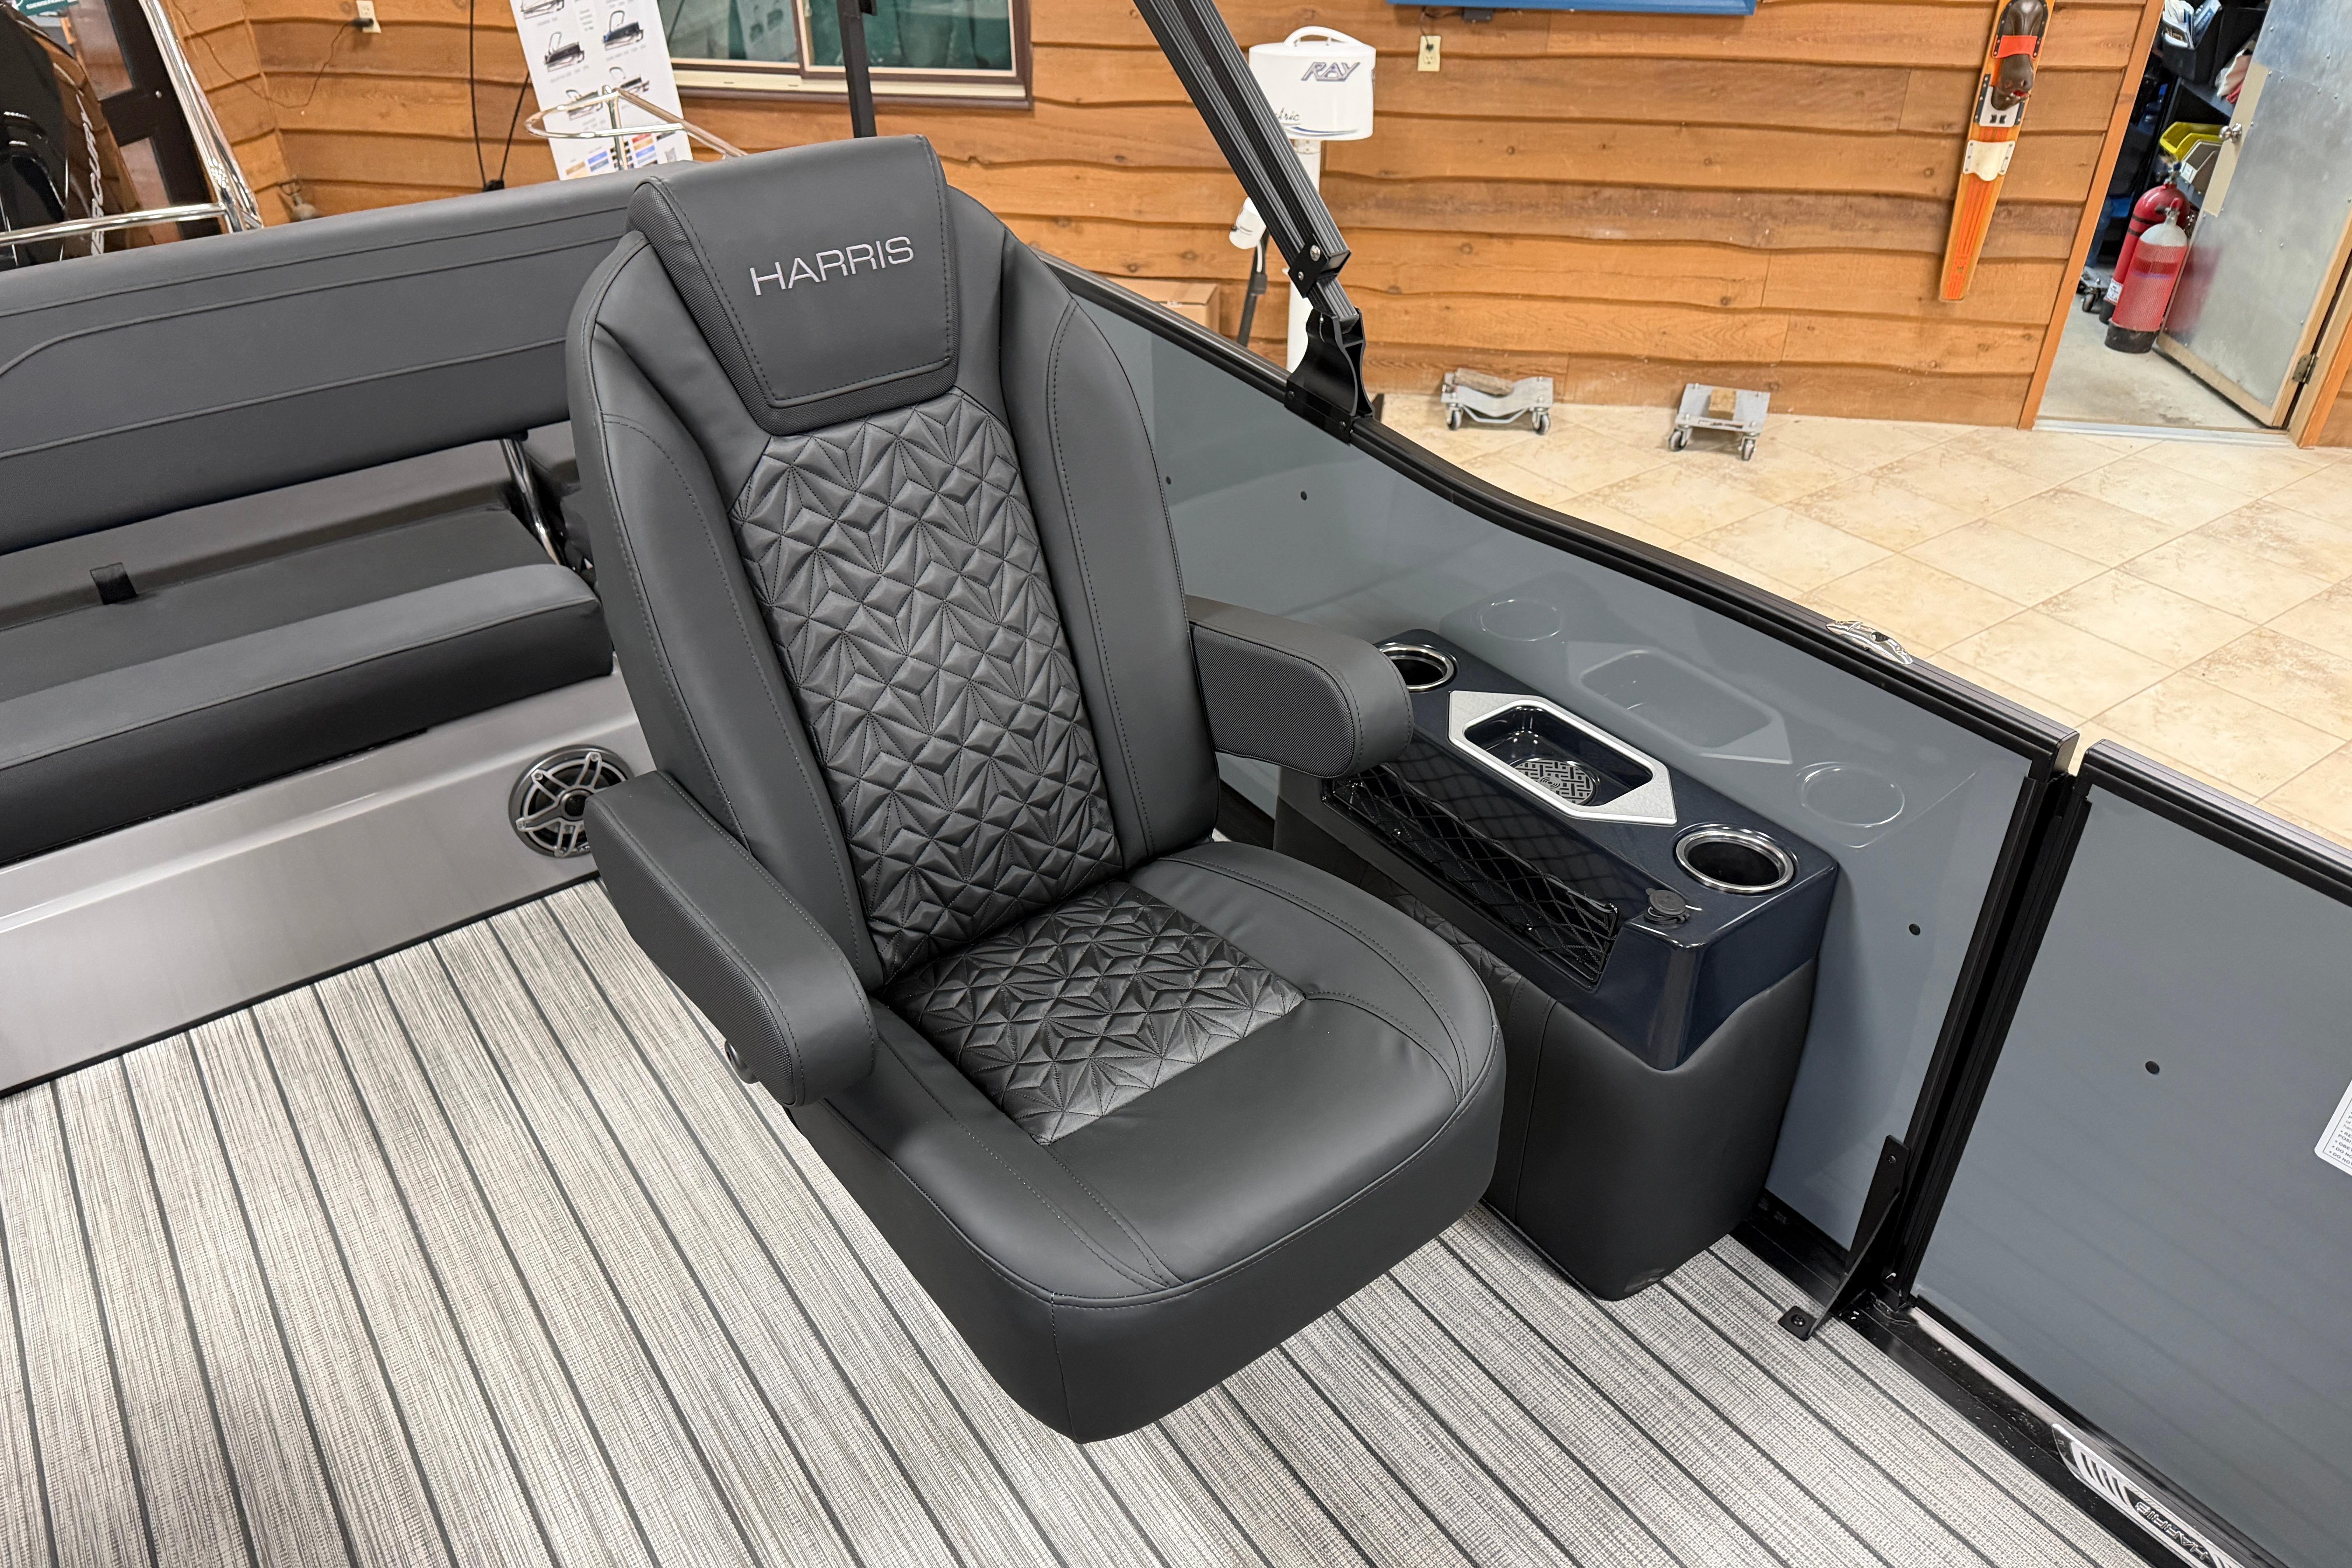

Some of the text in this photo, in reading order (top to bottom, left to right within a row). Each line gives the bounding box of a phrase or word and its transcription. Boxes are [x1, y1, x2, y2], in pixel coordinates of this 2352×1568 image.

[1301, 61, 1360, 82] RAY
[749, 236, 914, 296] HARRIS
[2338, 1134, 2352, 1144] POSI
[2135, 1501, 2208, 1560] HARRIS
